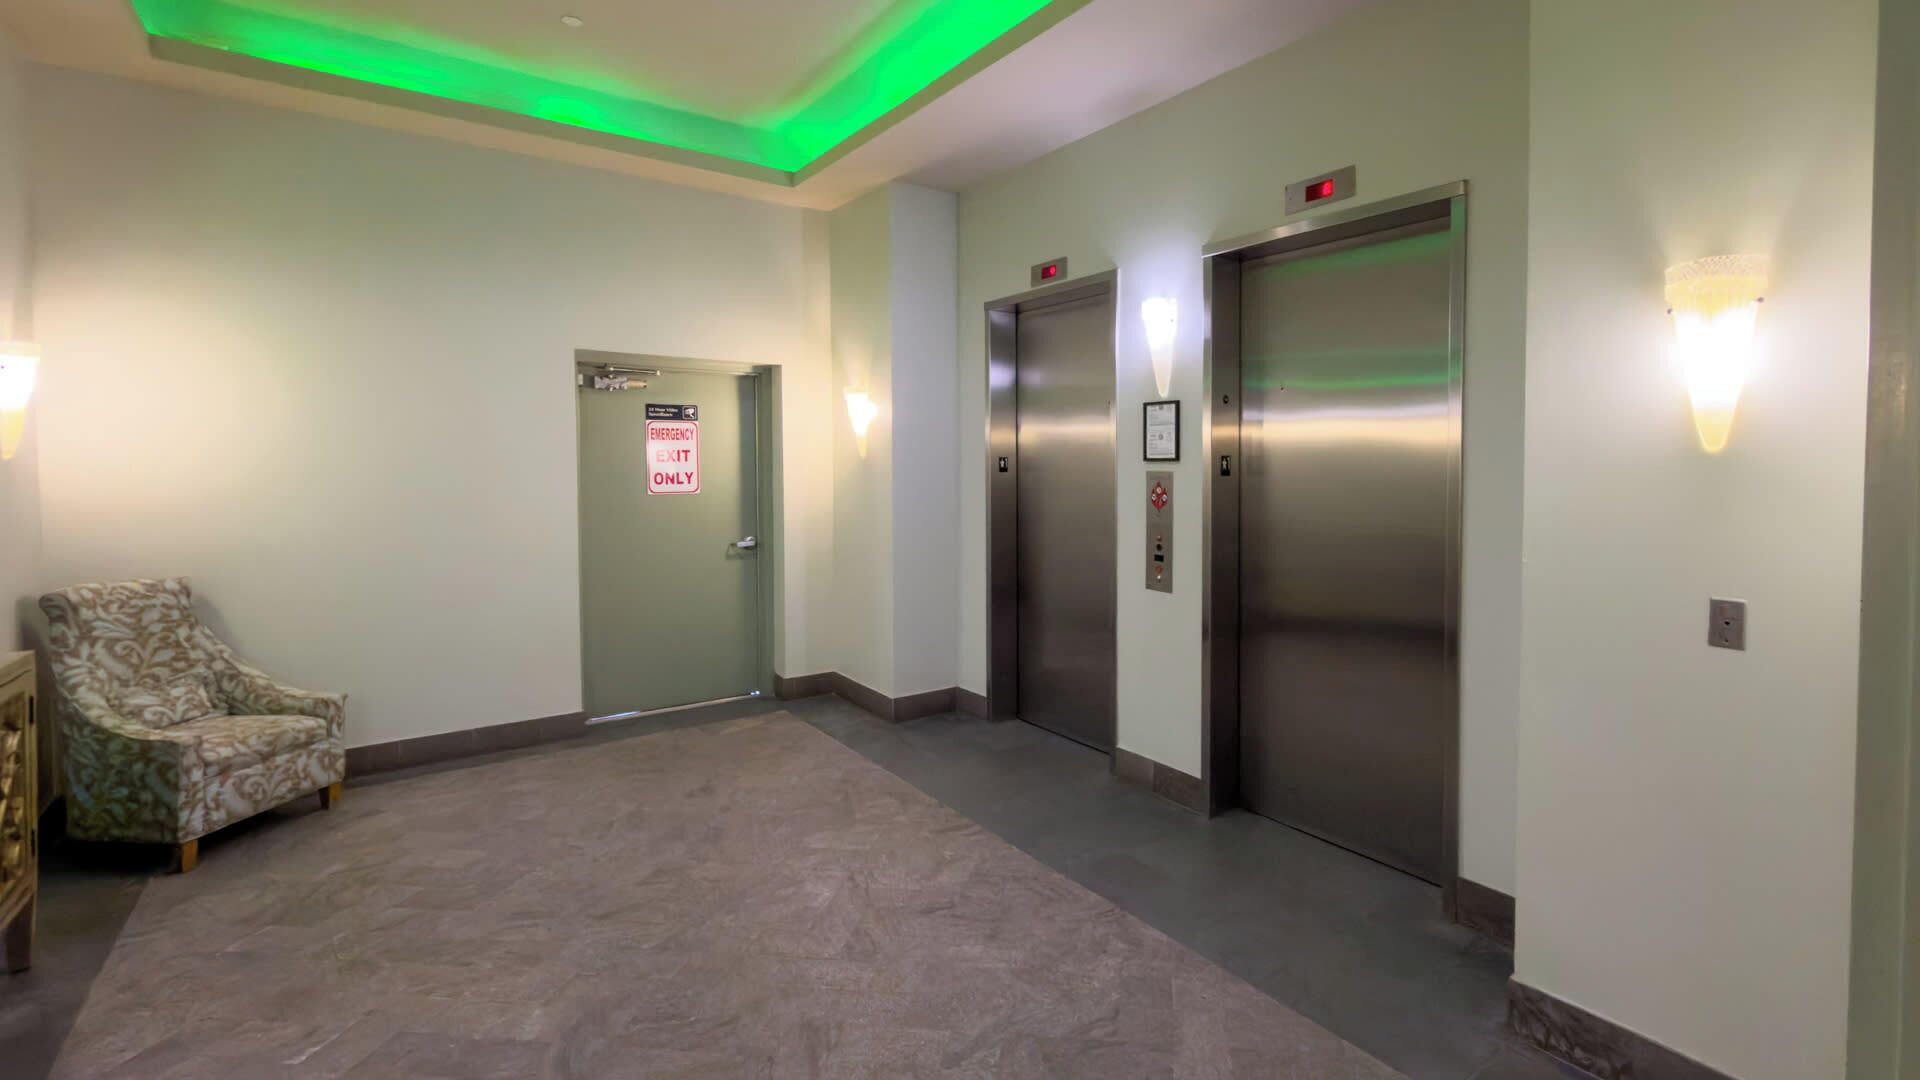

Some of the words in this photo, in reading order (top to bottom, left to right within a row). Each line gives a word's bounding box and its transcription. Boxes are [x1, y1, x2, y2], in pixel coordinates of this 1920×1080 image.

[650, 427, 694, 441] EMERGENCY
[656, 449, 691, 462] EXIT
[654, 472, 694, 485] ONLY
